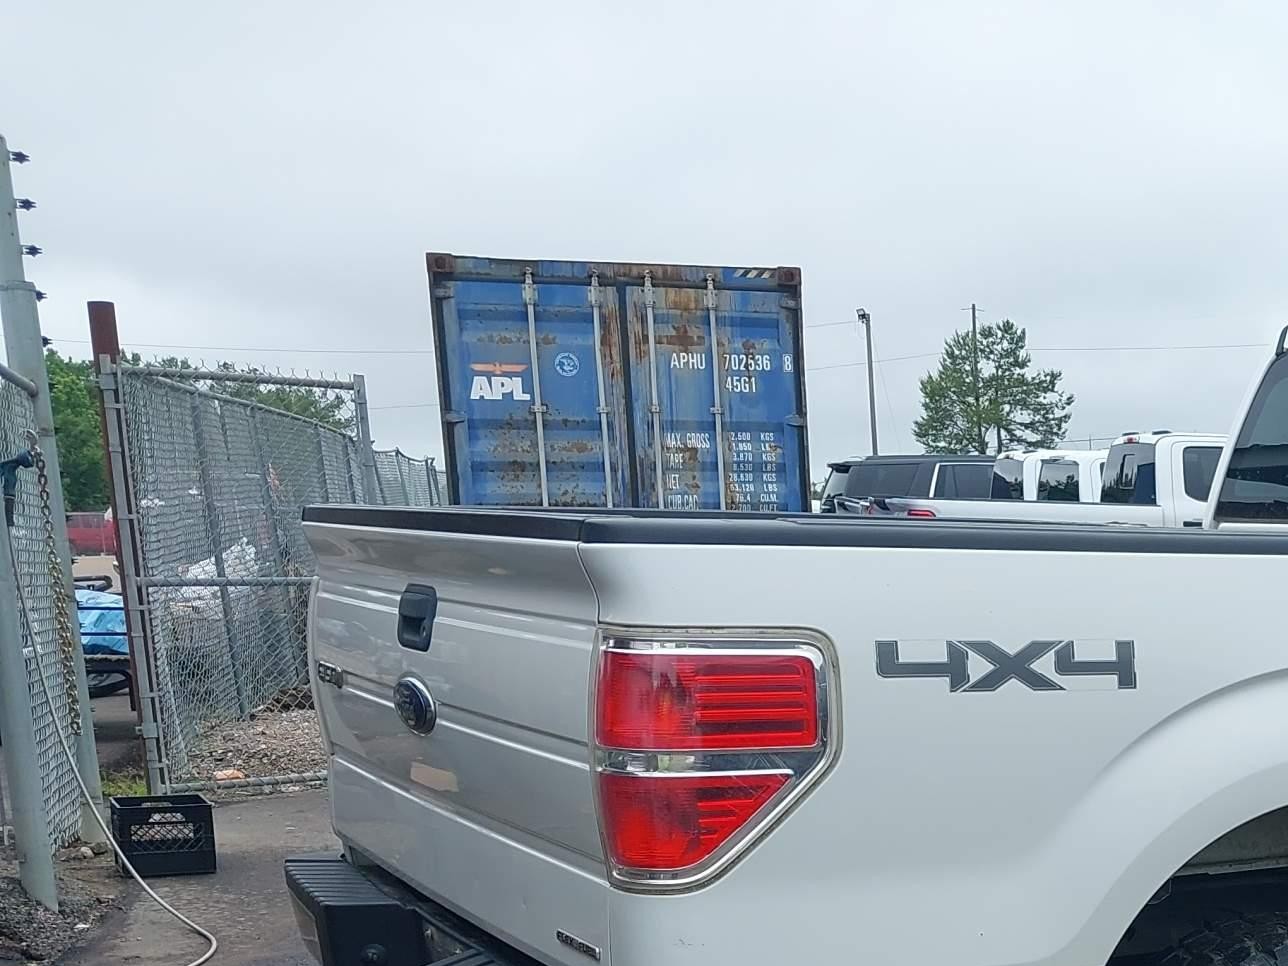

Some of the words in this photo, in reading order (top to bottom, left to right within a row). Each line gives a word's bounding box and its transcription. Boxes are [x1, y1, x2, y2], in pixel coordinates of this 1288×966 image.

[670, 352, 706, 370] APHU
[723, 354, 771, 371] 702536
[784, 354, 792, 371] 8
[470, 376, 531, 401] APL
[725, 376, 757, 393] 45G1
[664, 432, 685, 449] MAX.
[686, 432, 711, 449] GROSS
[730, 432, 751, 441] 2.500
[760, 432, 775, 441] KGS
[762, 453, 777, 462] KGS
[762, 463, 777, 472] LBS
[666, 474, 680, 490] NET
[763, 473, 777, 482] KGS
[763, 483, 779, 493] LBS
